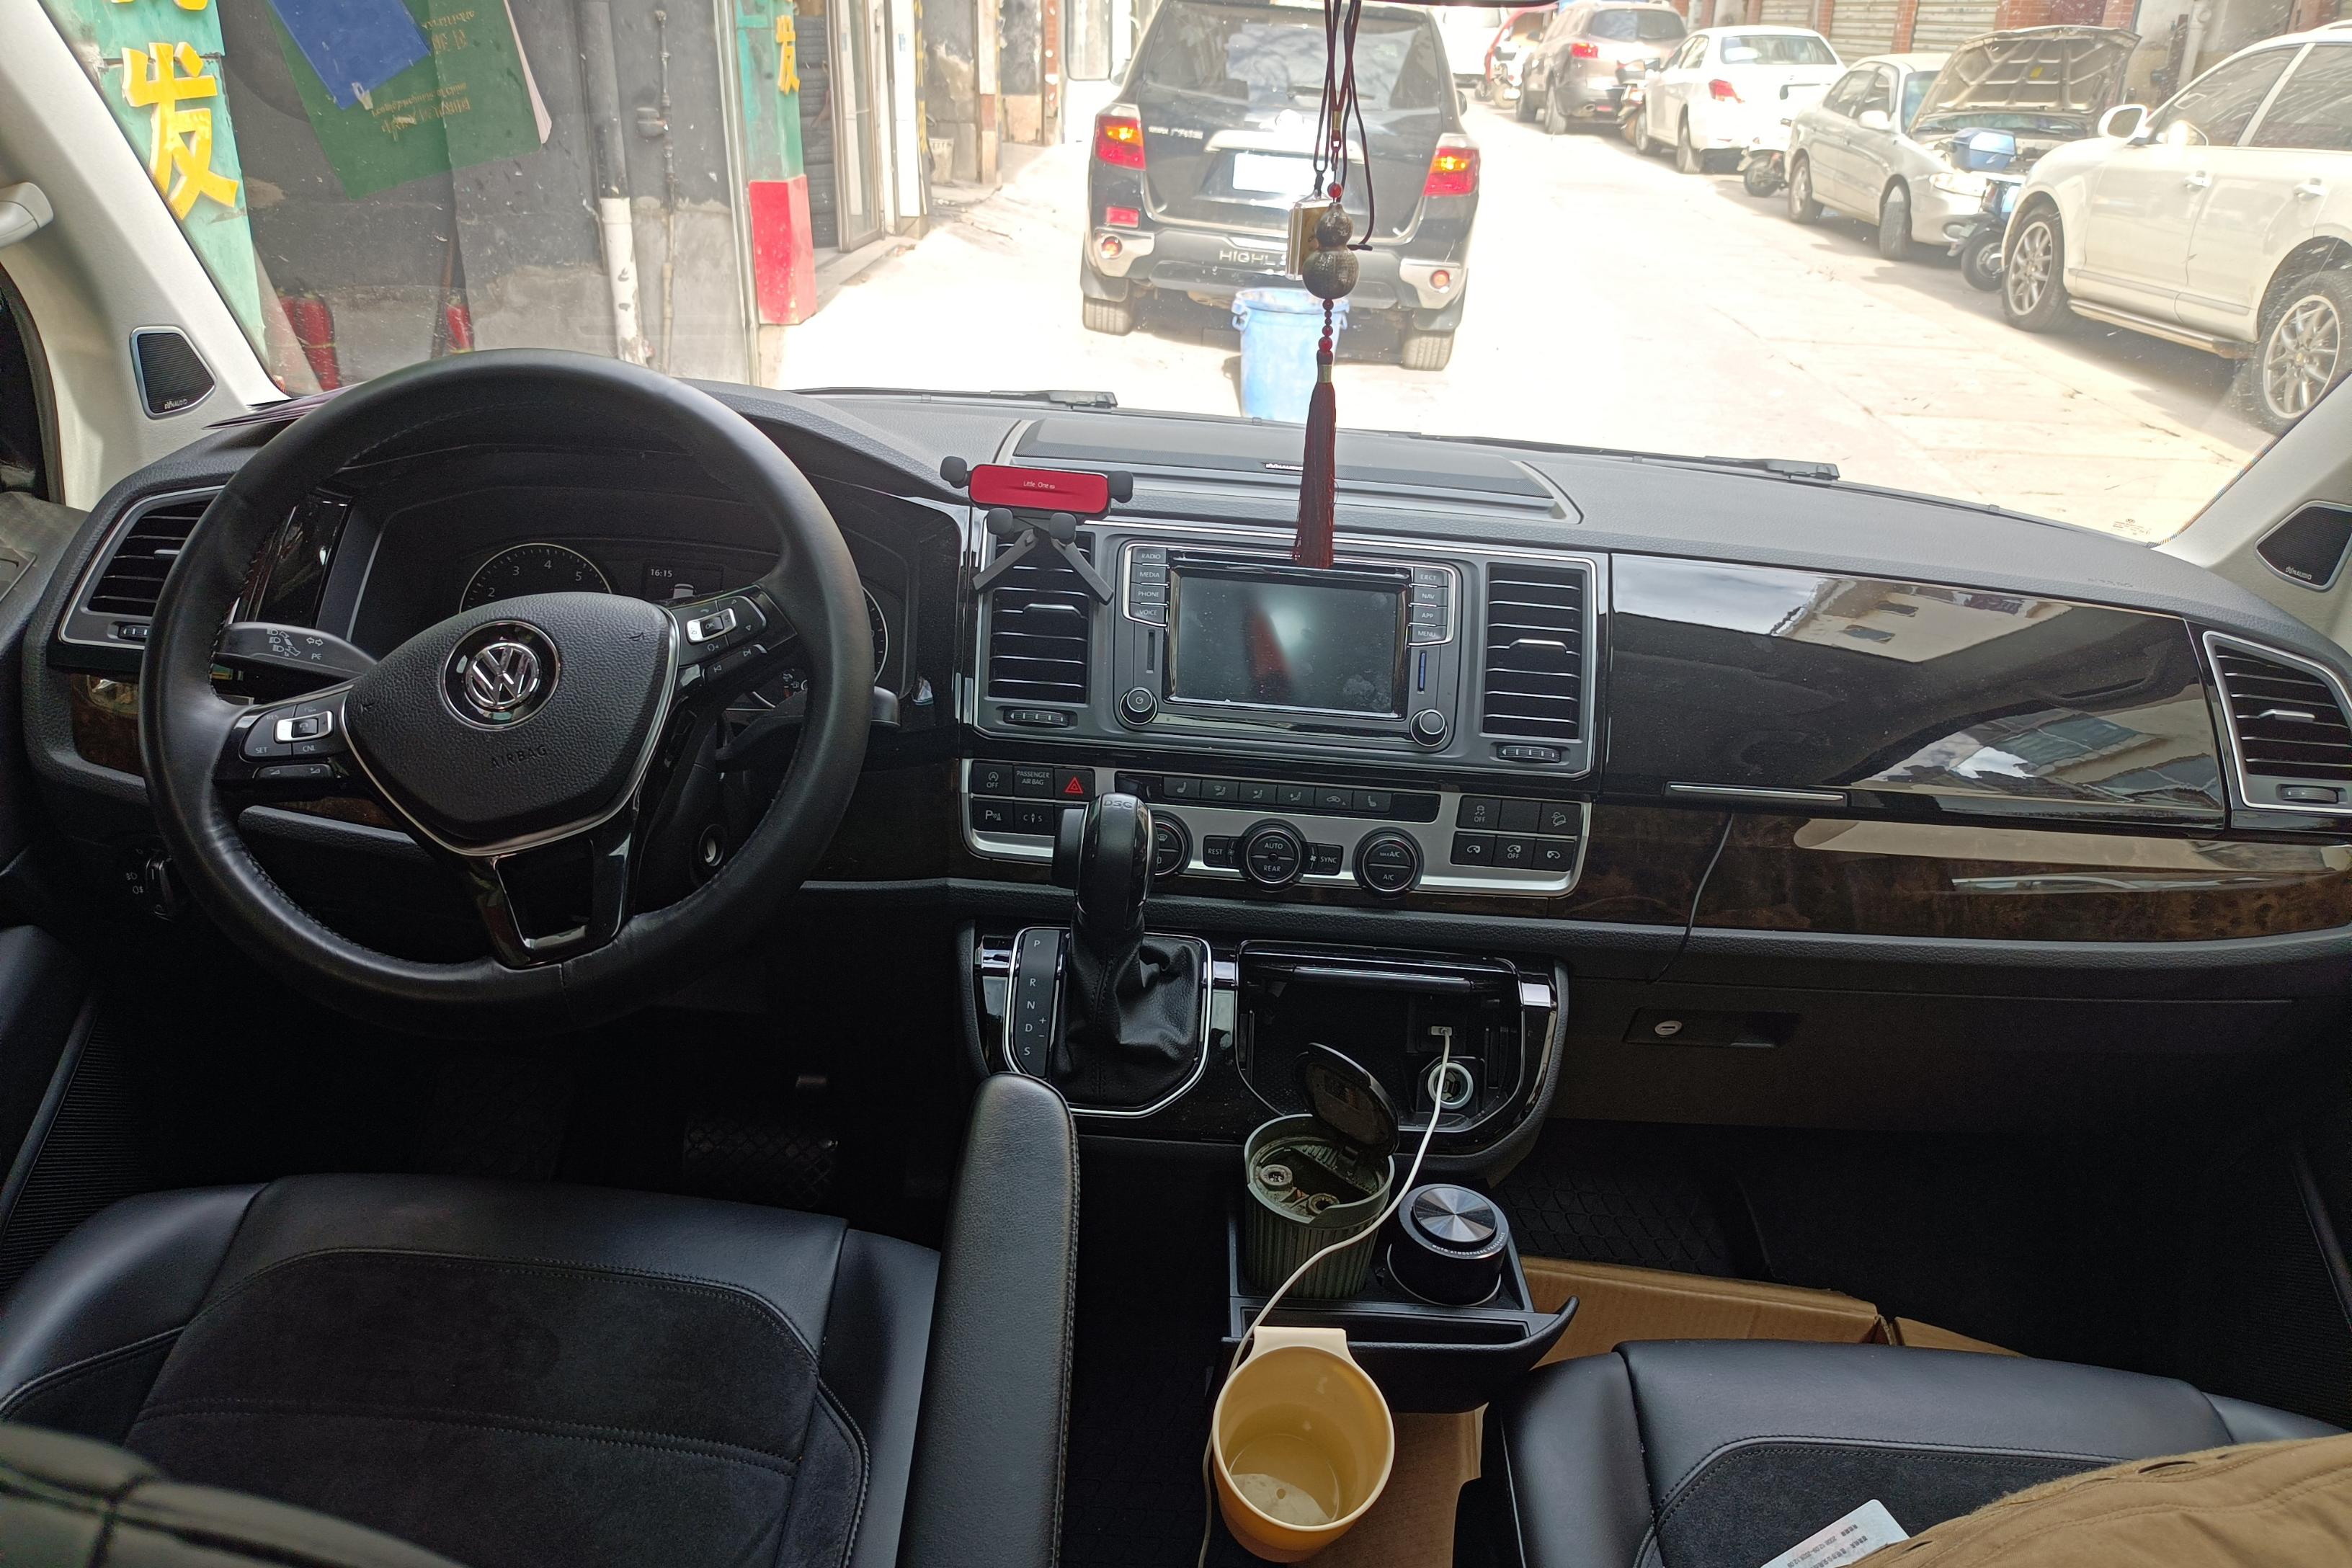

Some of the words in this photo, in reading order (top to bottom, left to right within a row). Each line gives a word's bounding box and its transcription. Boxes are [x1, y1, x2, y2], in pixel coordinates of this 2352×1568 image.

[121, 42, 239, 220] 发
[544, 560, 552, 570] 4
[512, 566, 520, 576] 3
[651, 568, 673, 578] 16:15
[574, 572, 582, 582] 5
[488, 587, 496, 597] 2
[705, 621, 716, 630] OK
[491, 744, 548, 769] AIRBAG
[1016, 770, 1050, 779] PASSENGER
[1102, 800, 1134, 809] DSG
[1264, 842, 1284, 850] AUTO
[1208, 847, 1224, 856] REST
[1319, 855, 1337, 865] SYNC
[1034, 940, 1041, 948] P
[1029, 978, 1036, 986] R
[1027, 1000, 1035, 1010] N
[1025, 1023, 1033, 1033] D
[1024, 1047, 1030, 1056] S
